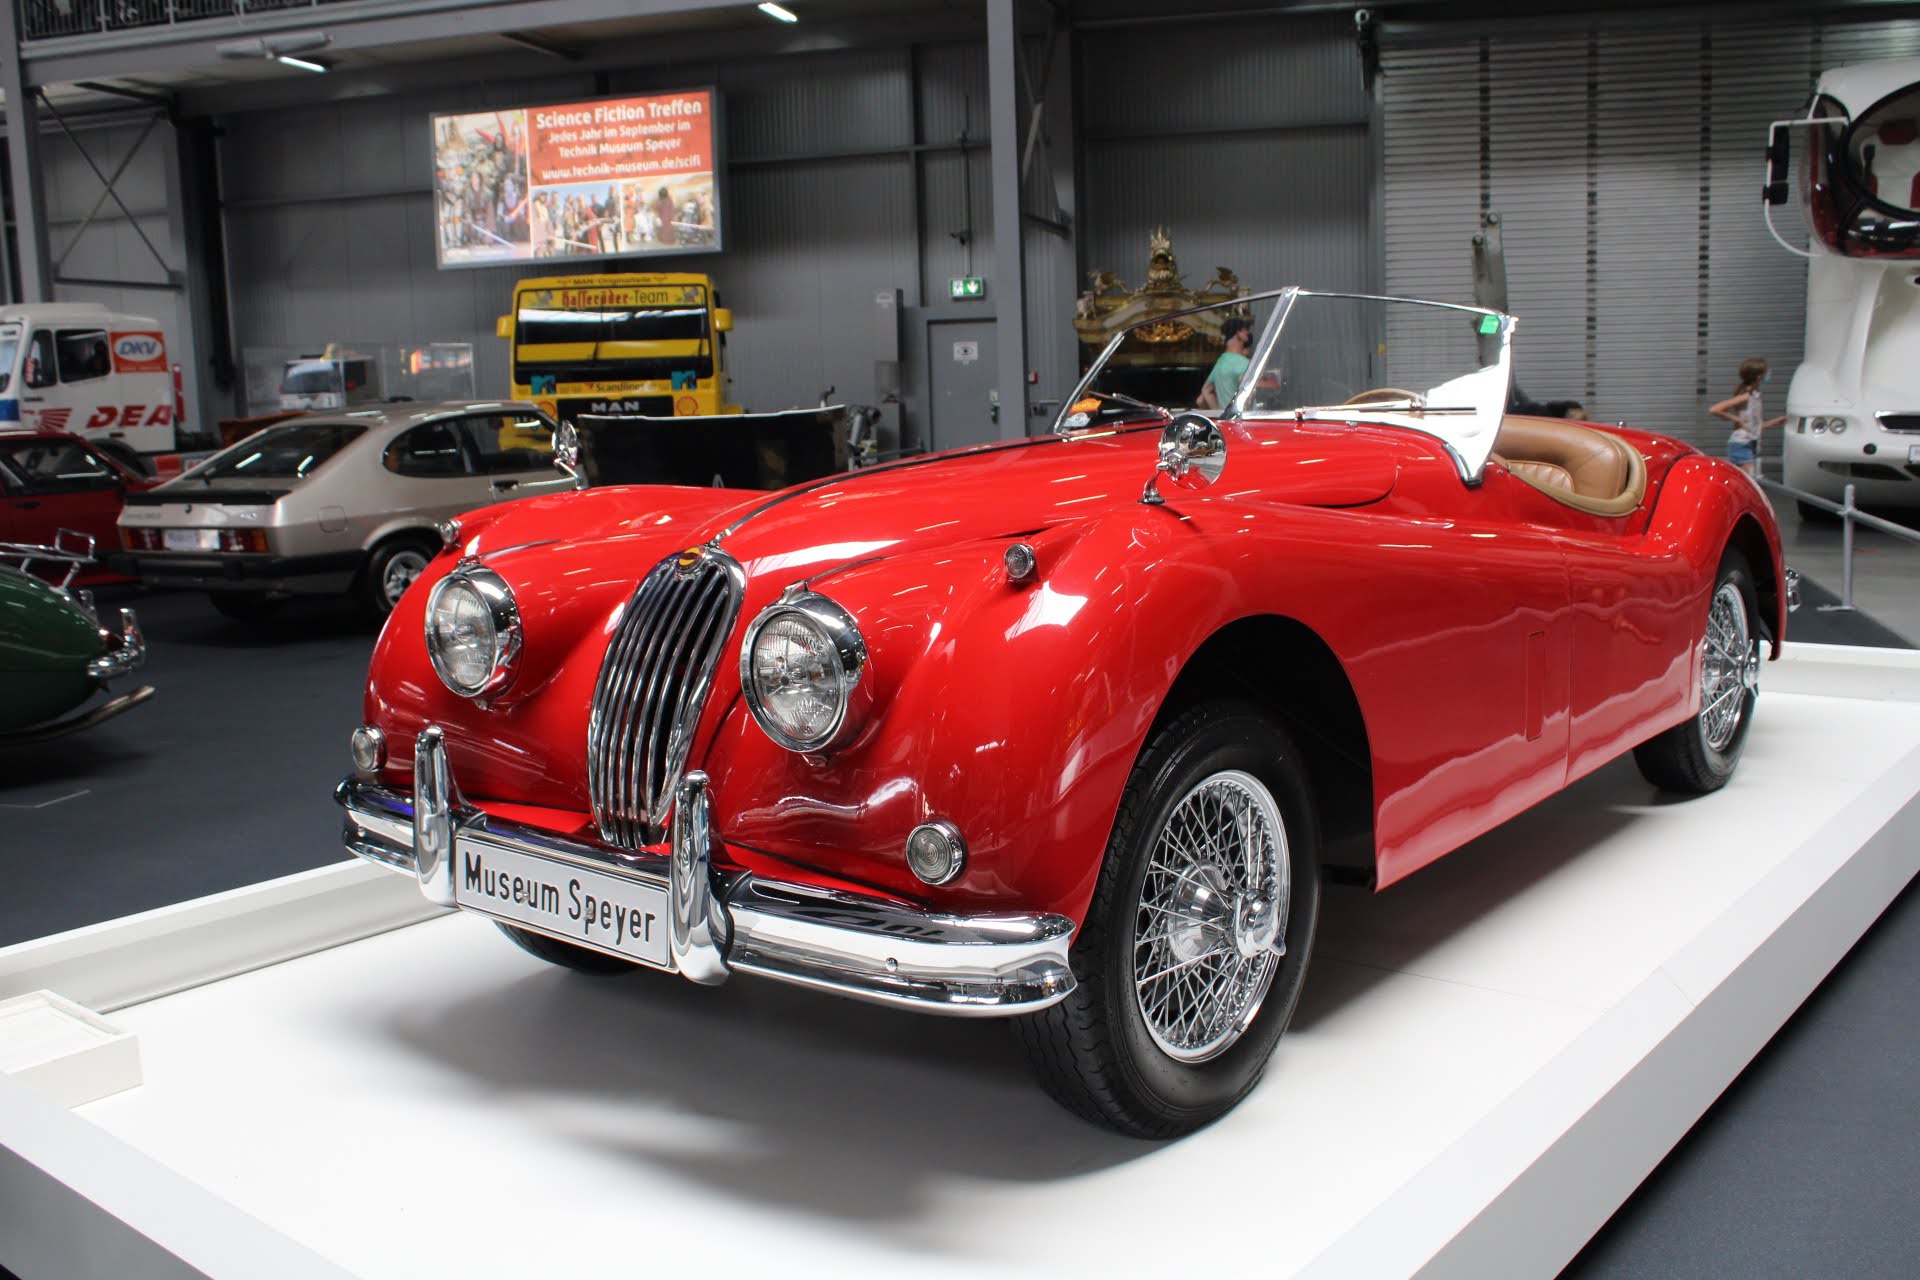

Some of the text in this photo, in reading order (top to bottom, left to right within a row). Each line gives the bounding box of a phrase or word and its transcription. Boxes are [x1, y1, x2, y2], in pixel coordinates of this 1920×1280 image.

[536, 99, 702, 130] Science Fiction Treffen
[549, 120, 691, 143] Jedes Jahr im September im
[559, 137, 681, 159] Technik Museum Speyer
[542, 154, 701, 181] www.technik-museum.de/scifi
[86, 405, 172, 429] DEA
[591, 401, 640, 413] MAN
[465, 851, 656, 945] Museum Speyer
